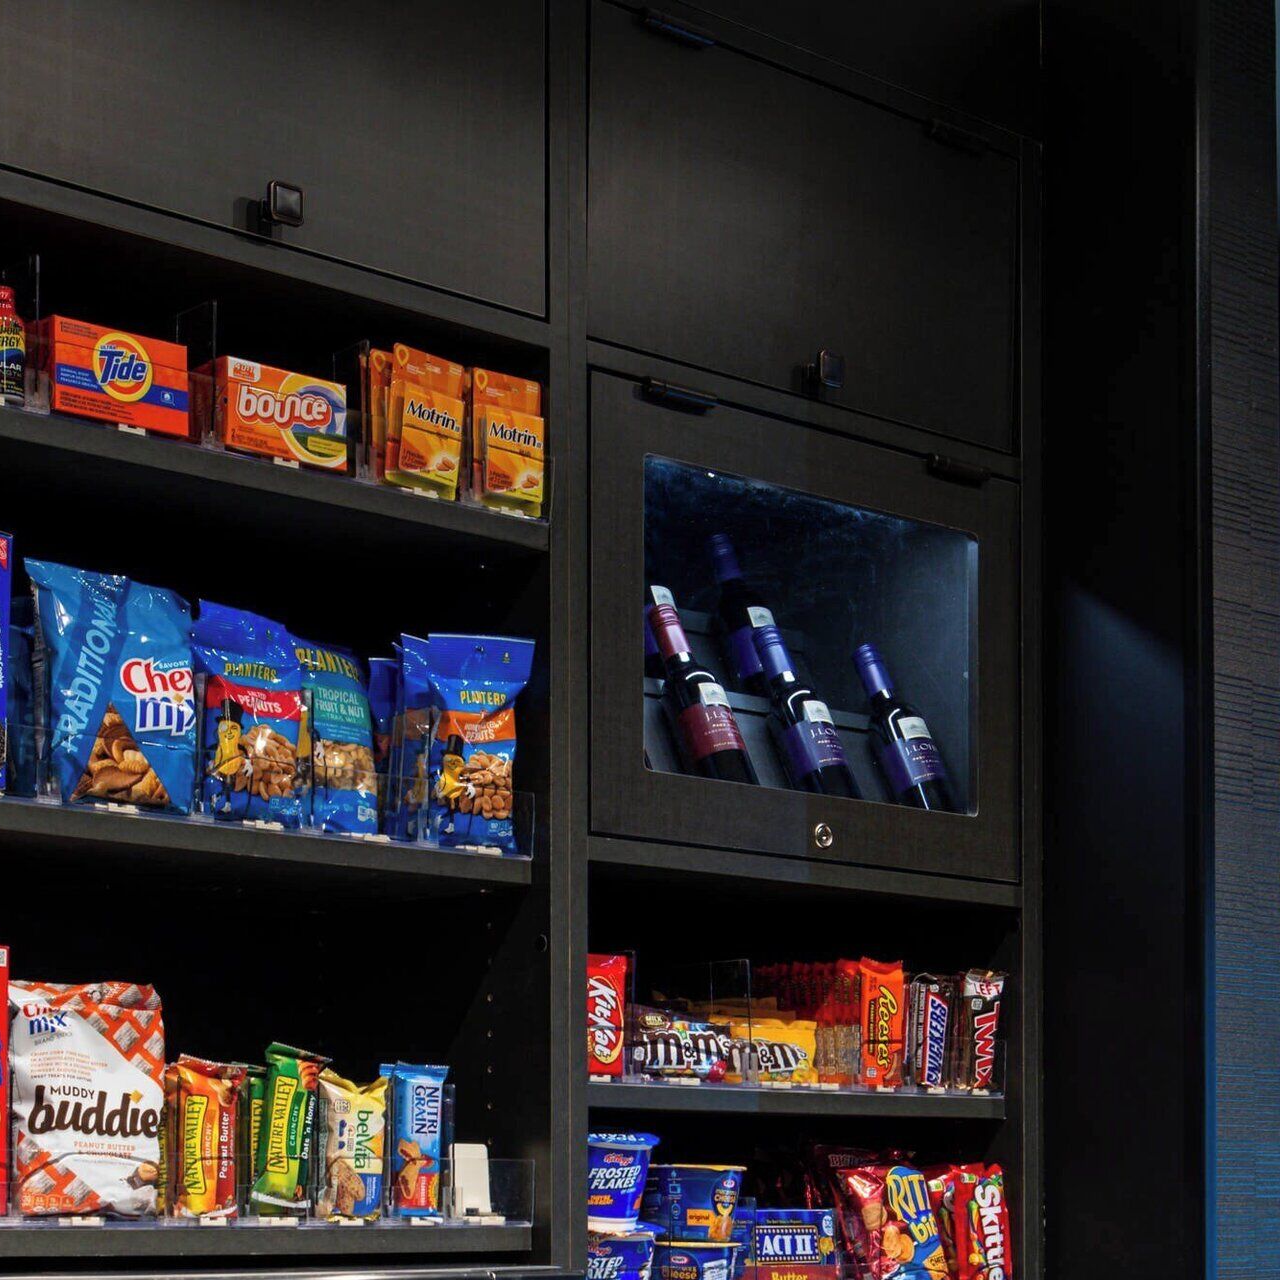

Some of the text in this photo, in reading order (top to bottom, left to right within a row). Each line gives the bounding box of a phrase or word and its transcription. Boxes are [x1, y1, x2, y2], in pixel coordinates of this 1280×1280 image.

[99, 350, 148, 385] Tide
[239, 383, 329, 423] bounce
[406, 400, 456, 431] Motrin
[489, 421, 537, 448] Motrin
[52, 600, 118, 753] TRADITIONAL
[121, 658, 195, 695] Chex
[158, 659, 190, 670] SAVORY
[224, 661, 278, 682] PLANTERS
[237, 693, 282, 714] PEANUTS
[314, 699, 365, 719] FRUIT & NUT
[317, 686, 359, 705] TROPICAL
[460, 690, 507, 706] PLANTERS
[974, 982, 1003, 996] LEFT
[877, 985, 898, 1069] Reese's
[925, 999, 948, 1087] SNICKERS
[50, 1085, 95, 1100] MUDDY
[27, 1084, 162, 1139] buddie
[289, 1105, 299, 1146] CRUNCHY
[414, 1085, 428, 1136] GRAIN
[425, 1086, 440, 1135] NUTRI
[301, 1095, 316, 1160] Date Honey
[354, 1109, 374, 1170] belVita
[74, 1140, 136, 1152] PEANUT BUTTER
[205, 1122, 213, 1166] CRUNCHY
[219, 1111, 230, 1179] Peanut Butter
[588, 1165, 642, 1180] FROSTED
[590, 1176, 637, 1190] FLAKES
[688, 1213, 710, 1222] original
[762, 1234, 813, 1256] ACT II
